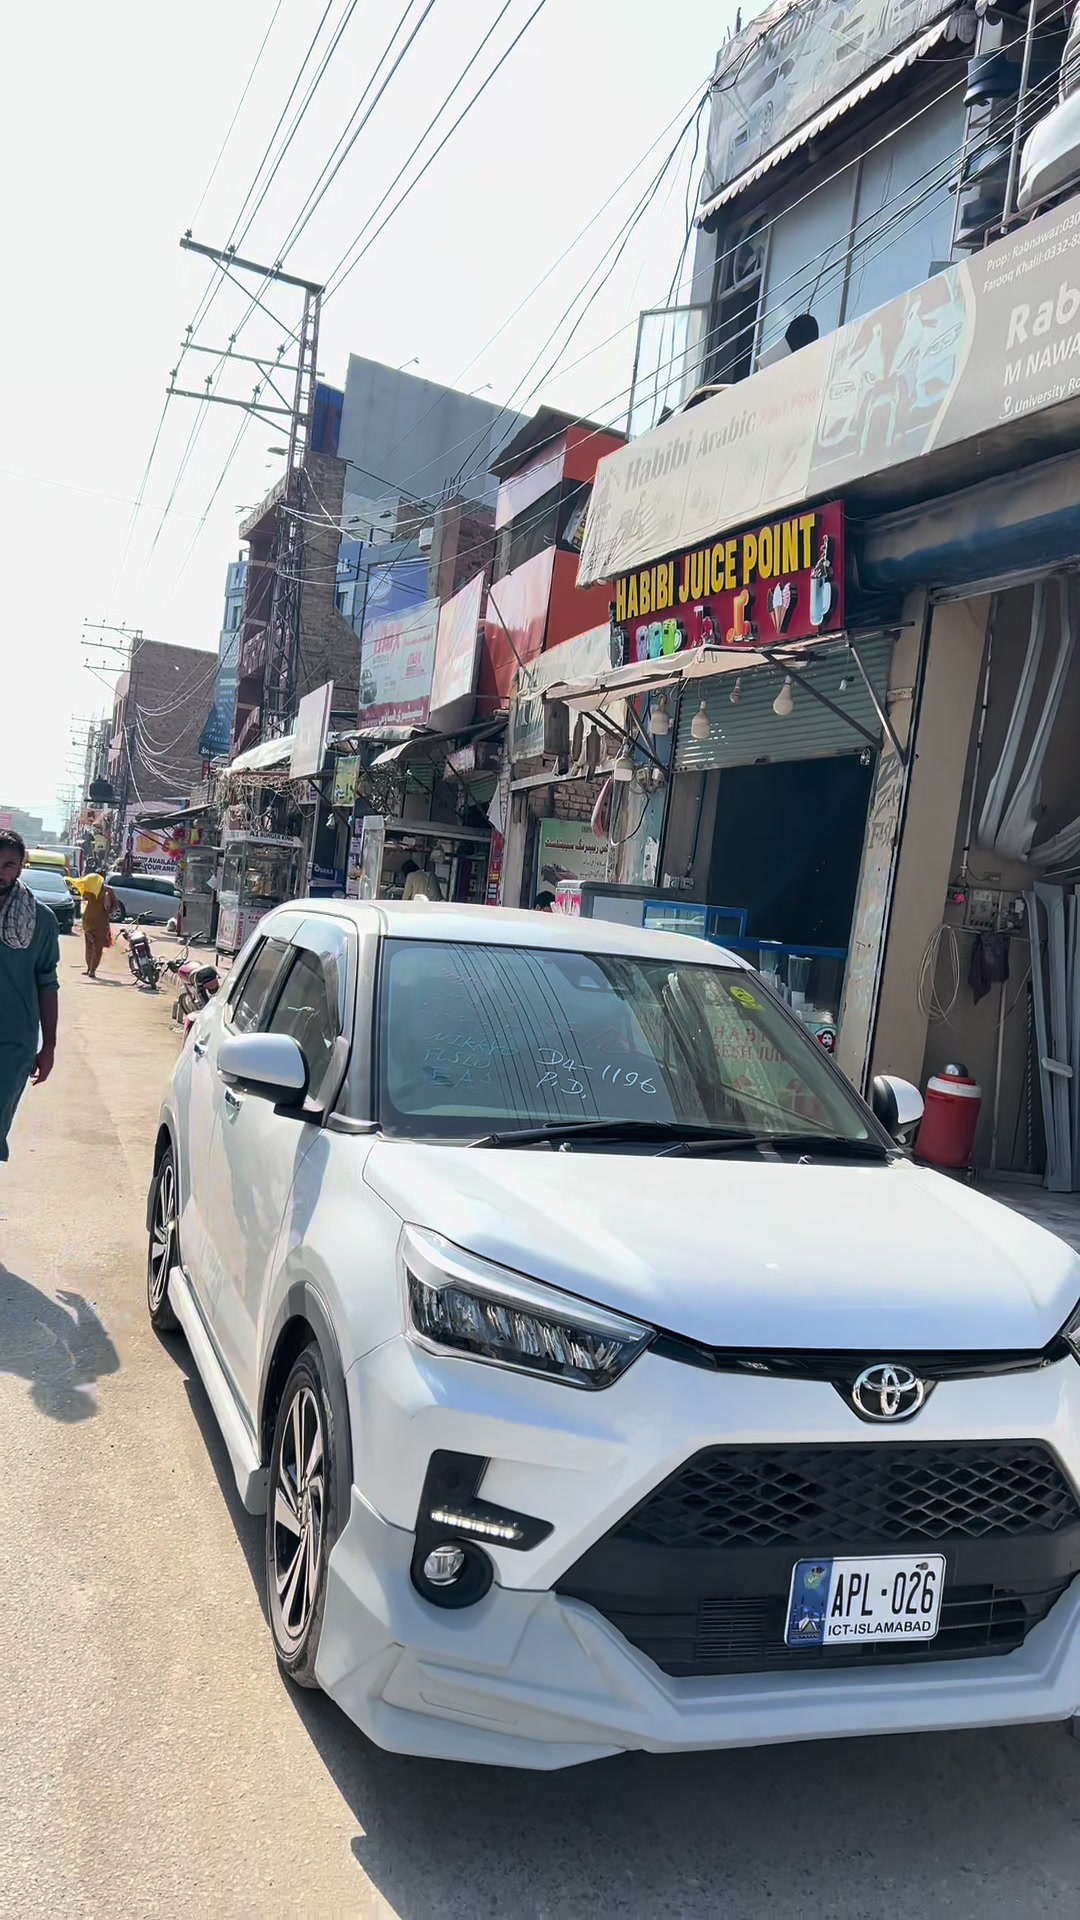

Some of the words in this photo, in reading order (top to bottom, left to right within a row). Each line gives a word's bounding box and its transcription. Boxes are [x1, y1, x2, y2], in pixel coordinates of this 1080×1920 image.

[983, 269, 1014, 294] Farooq
[1003, 357, 1022, 387] M
[1014, 382, 1066, 413] University
[624, 430, 694, 493] Habibi
[696, 410, 758, 460] Arabic
[616, 560, 675, 622] HABIBI
[678, 538, 737, 604] JUICE
[743, 512, 816, 585] POINT
[828, 1620, 932, 1637] ICT-ISLAMABAD
